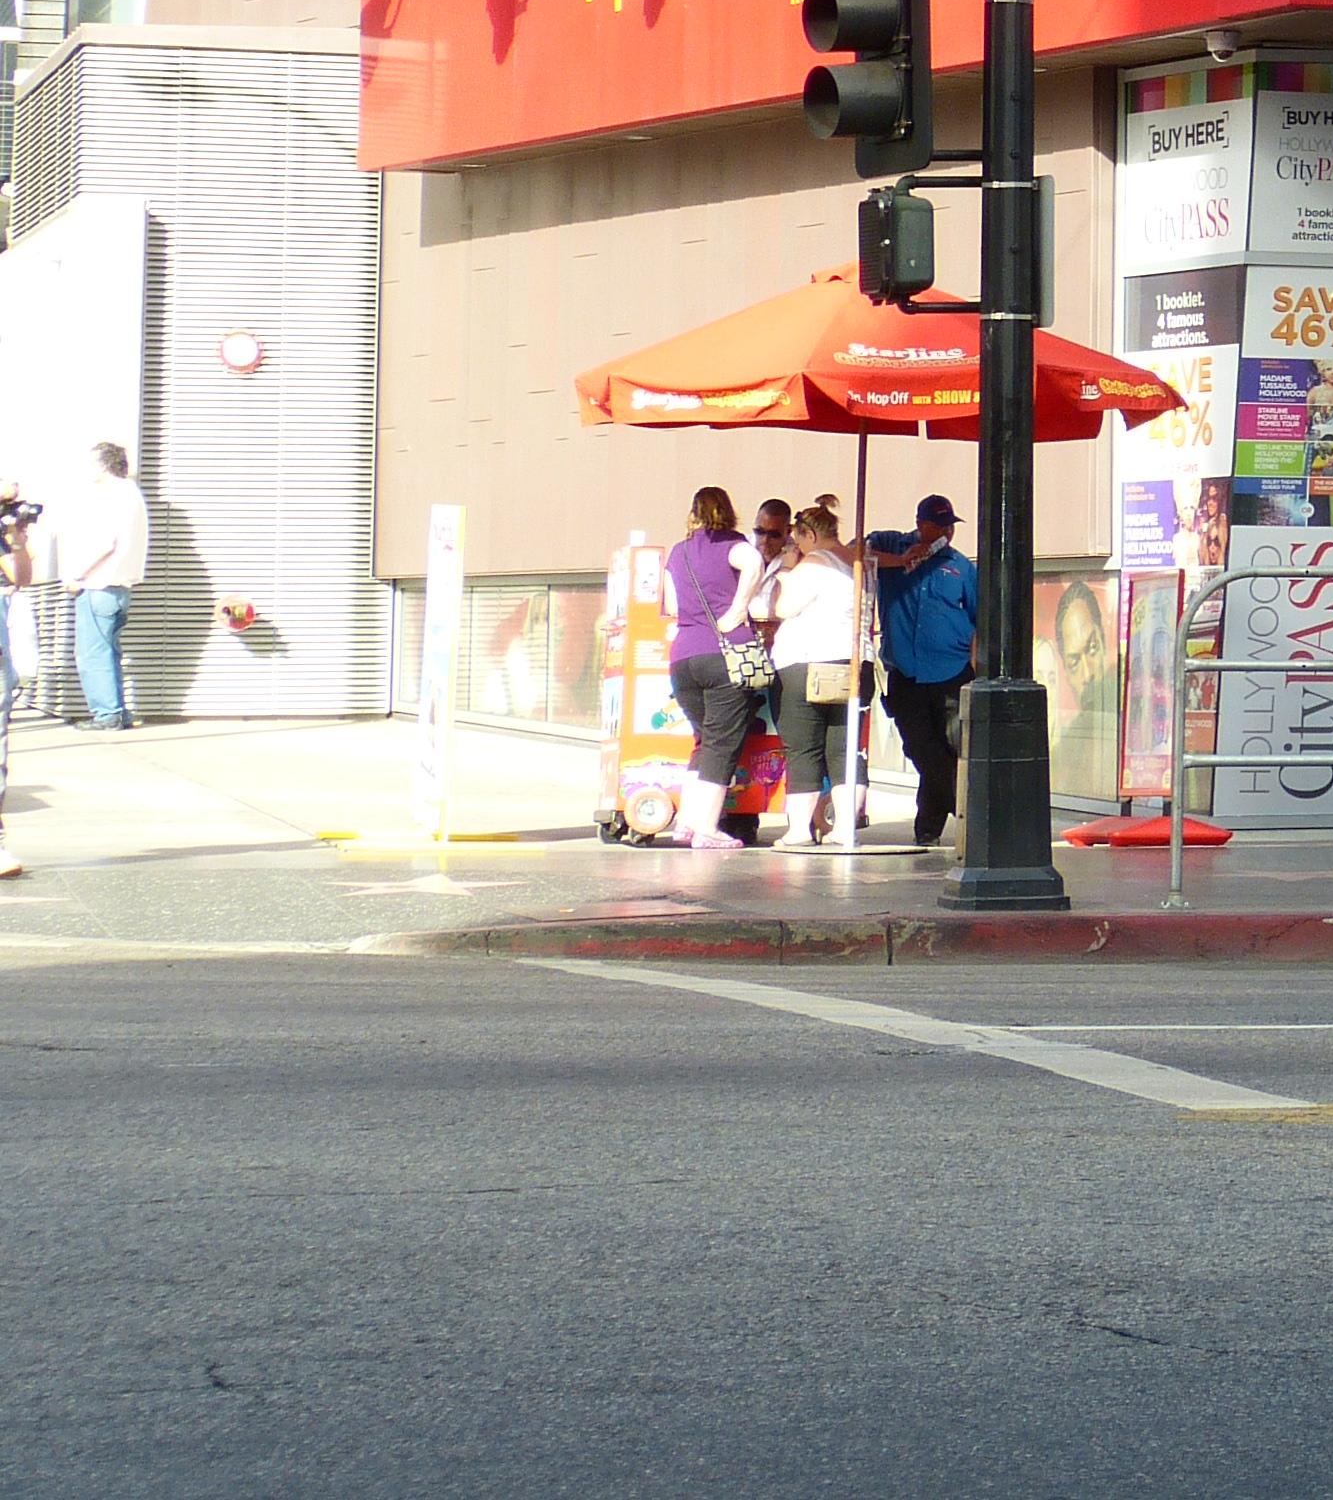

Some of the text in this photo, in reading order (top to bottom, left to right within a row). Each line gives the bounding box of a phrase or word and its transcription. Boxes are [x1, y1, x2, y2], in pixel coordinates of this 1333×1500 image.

[1286, 110, 1321, 126] BUY
[1152, 117, 1225, 155] BUY HERE
[1296, 207, 1303, 218] 1
[1297, 219, 1305, 229] 4
[1155, 291, 1206, 309] 1 booklet.
[1156, 311, 1205, 330] 4 famous
[1151, 329, 1209, 349] attractions.
[934, 390, 974, 405] SHOW
